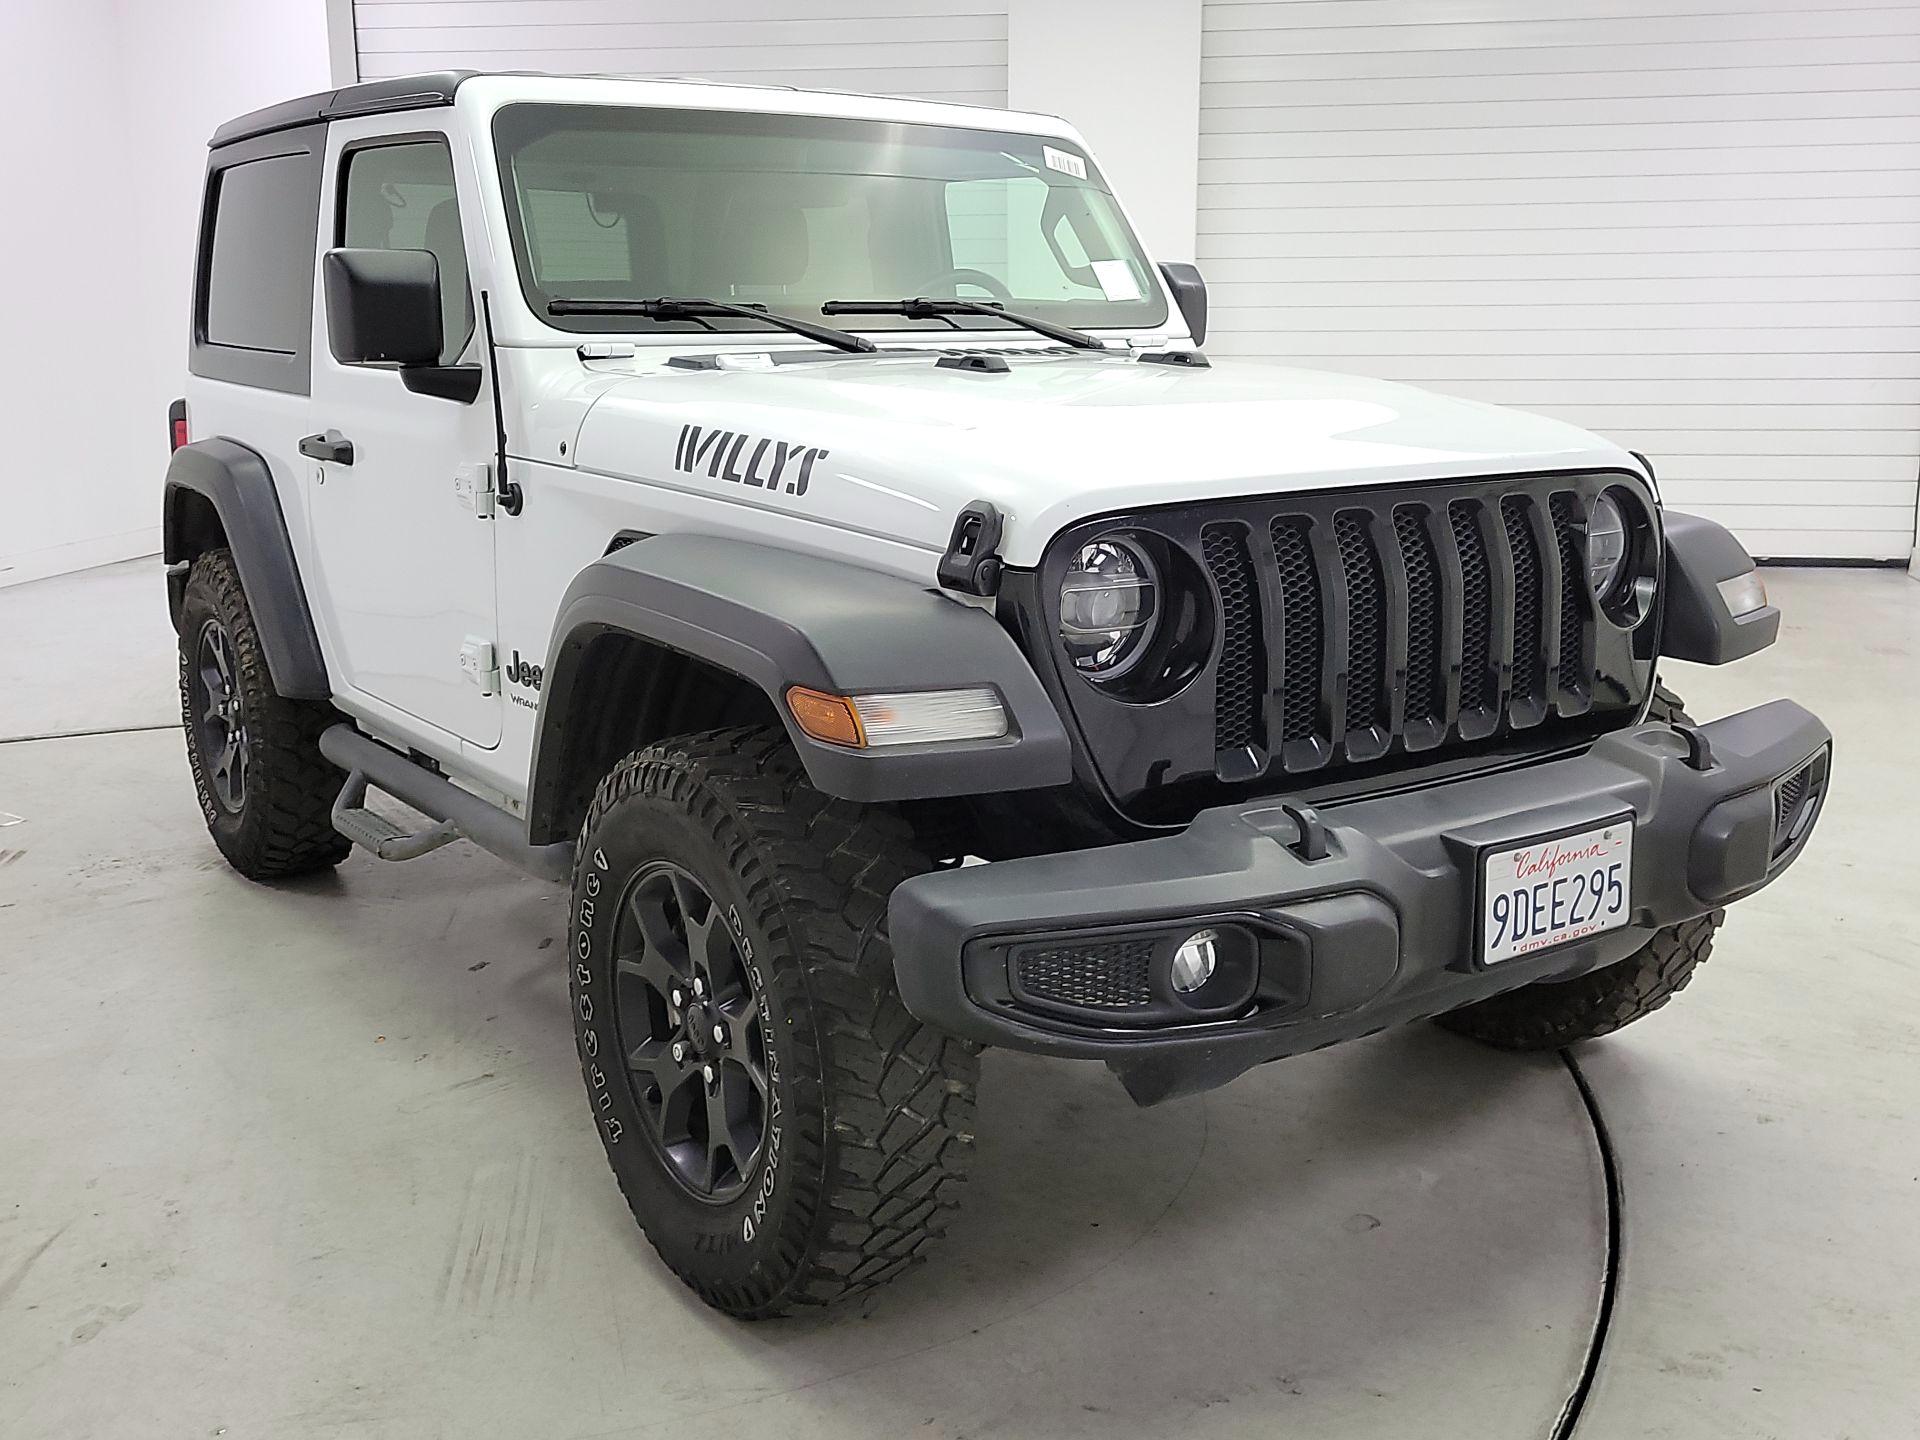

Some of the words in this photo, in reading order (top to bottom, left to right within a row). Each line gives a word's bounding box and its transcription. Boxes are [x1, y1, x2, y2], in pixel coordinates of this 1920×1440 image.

[675, 424, 829, 496] WILLYS
[506, 650, 542, 691] Jee
[510, 693, 538, 711] WRAN
[1516, 843, 1608, 879] California
[1491, 863, 1622, 949] 9DEE295
[1520, 924, 1597, 952] dmv.ca.gov
[729, 904, 780, 1225] DESTINATION
